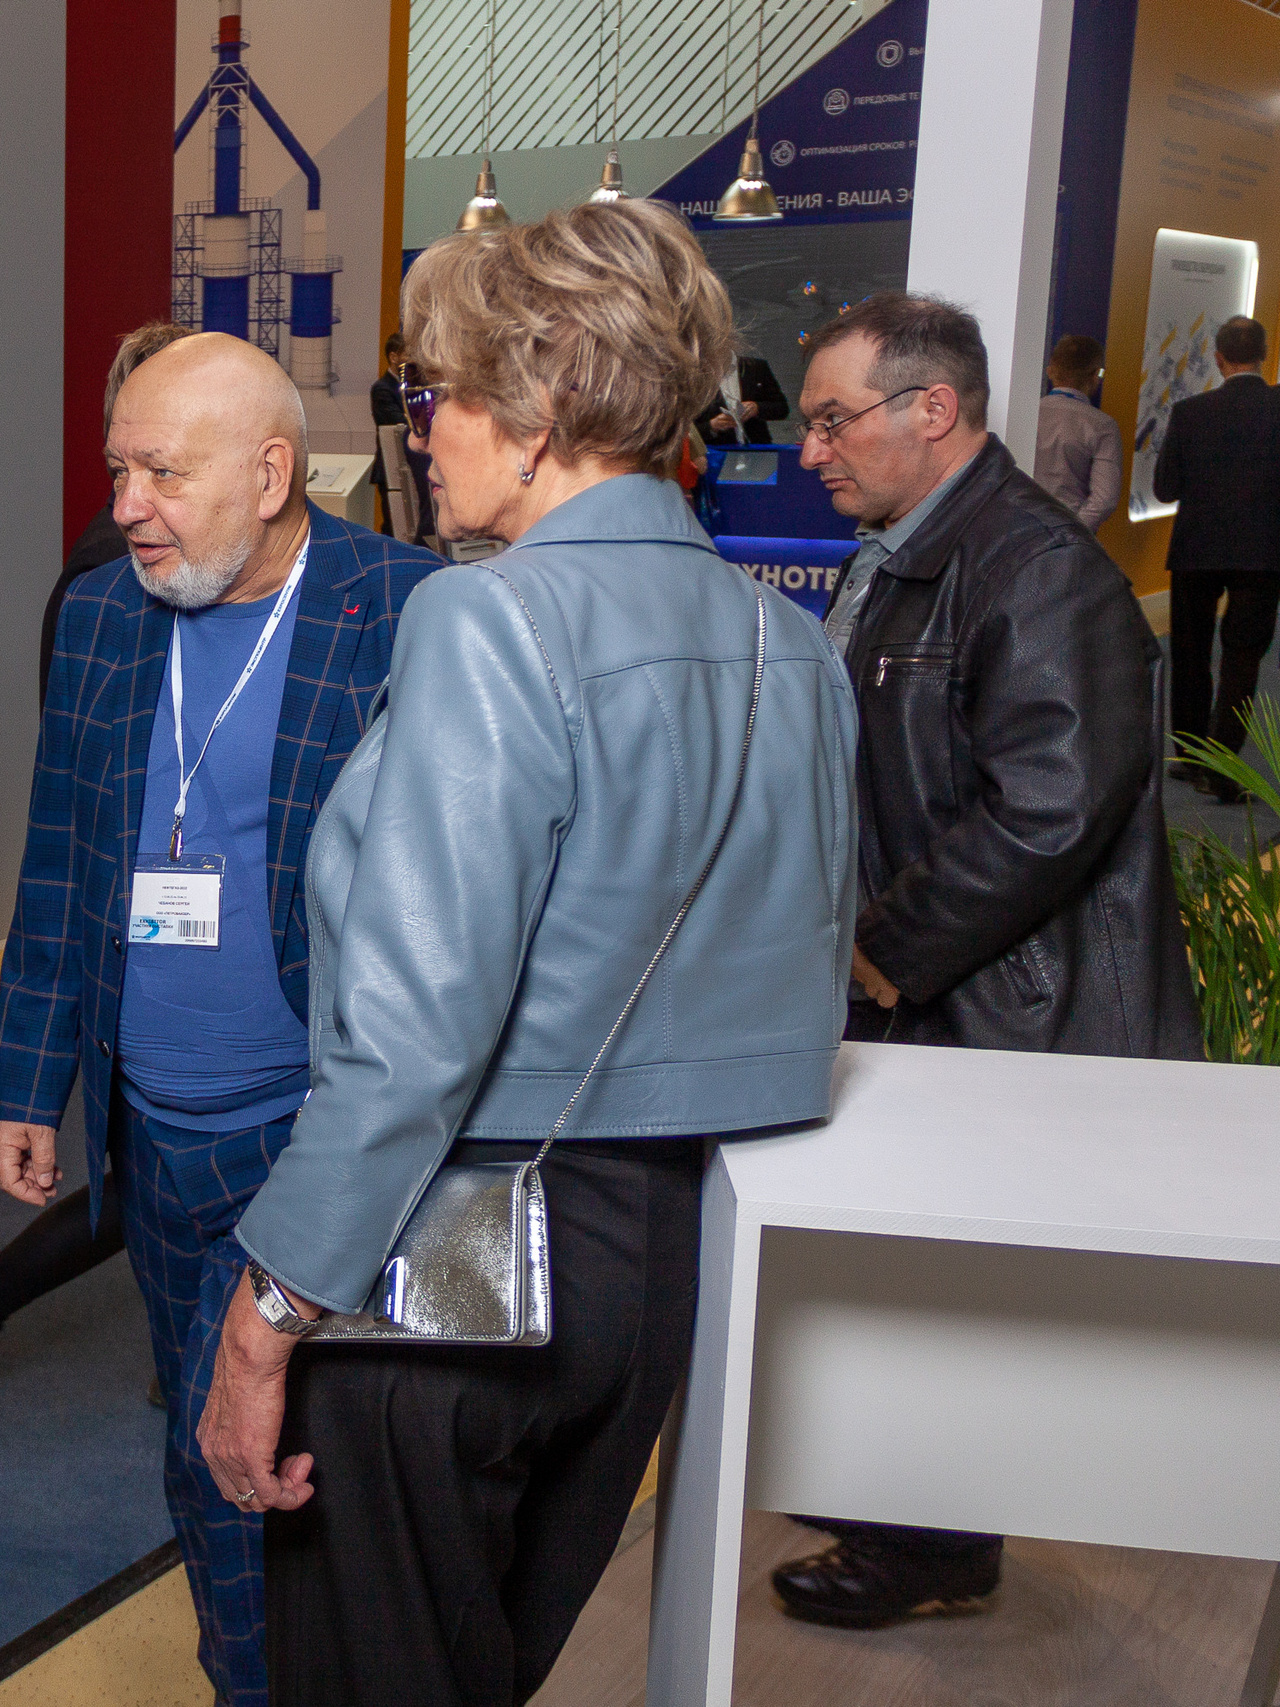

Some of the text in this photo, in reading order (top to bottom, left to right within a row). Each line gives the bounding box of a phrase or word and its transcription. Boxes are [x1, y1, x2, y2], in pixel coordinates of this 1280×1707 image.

[854, 92, 907, 105] ПЕРЕДОВЫЕ
[800, 144, 868, 157] ОПТИМИЗАЦИЯ
[838, 188, 892, 207] ВАША
